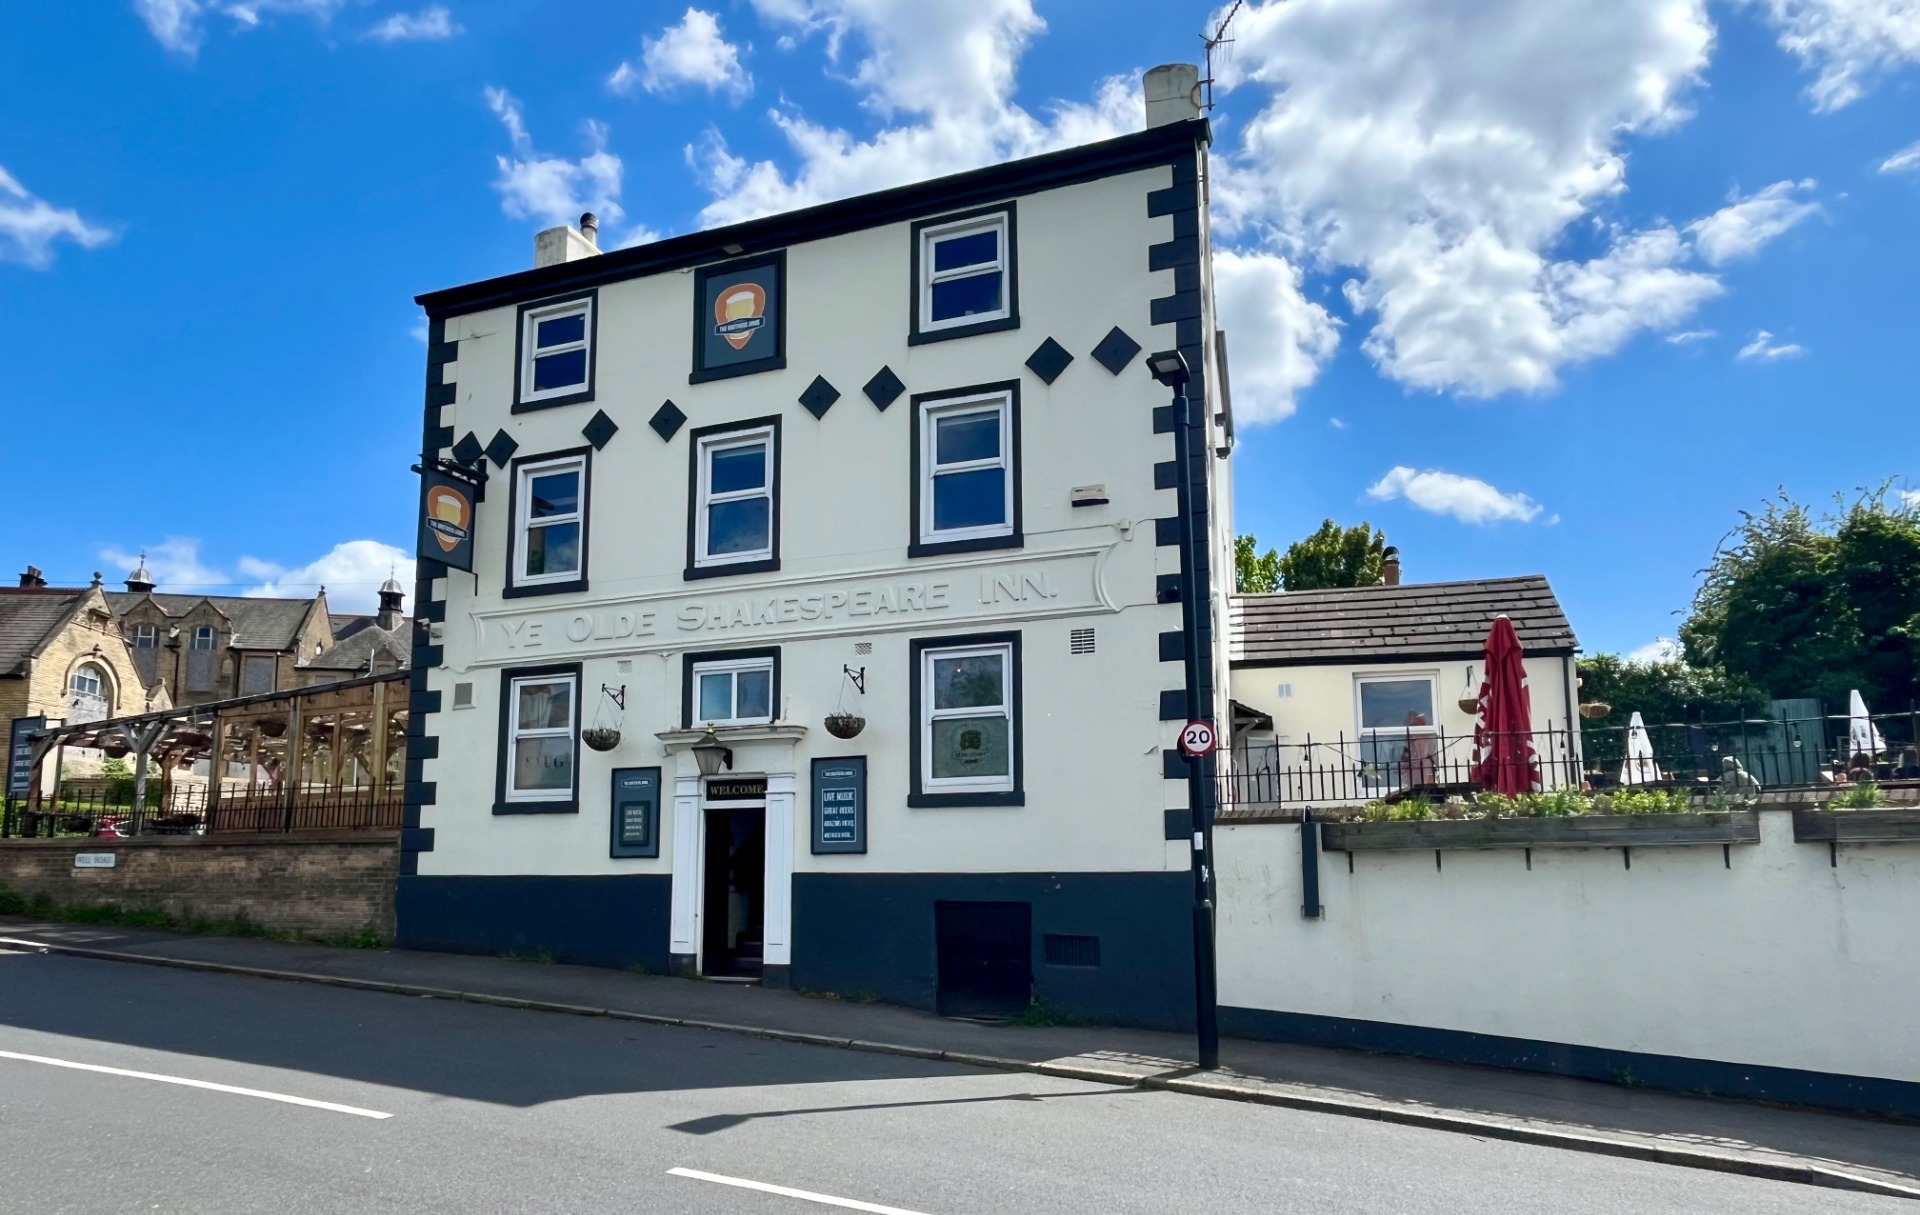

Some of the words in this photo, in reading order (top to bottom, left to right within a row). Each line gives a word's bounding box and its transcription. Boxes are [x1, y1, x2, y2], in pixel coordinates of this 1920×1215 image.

[501, 619, 543, 648] YE
[566, 612, 656, 642] OLDE
[677, 582, 949, 631] SHAKESPEARE
[1186, 730, 1210, 744] 20
[710, 784, 765, 795] WELCOME
[823, 792, 836, 801] LIVE
[837, 791, 854, 801] MUSIC
[823, 807, 838, 815] GREAT
